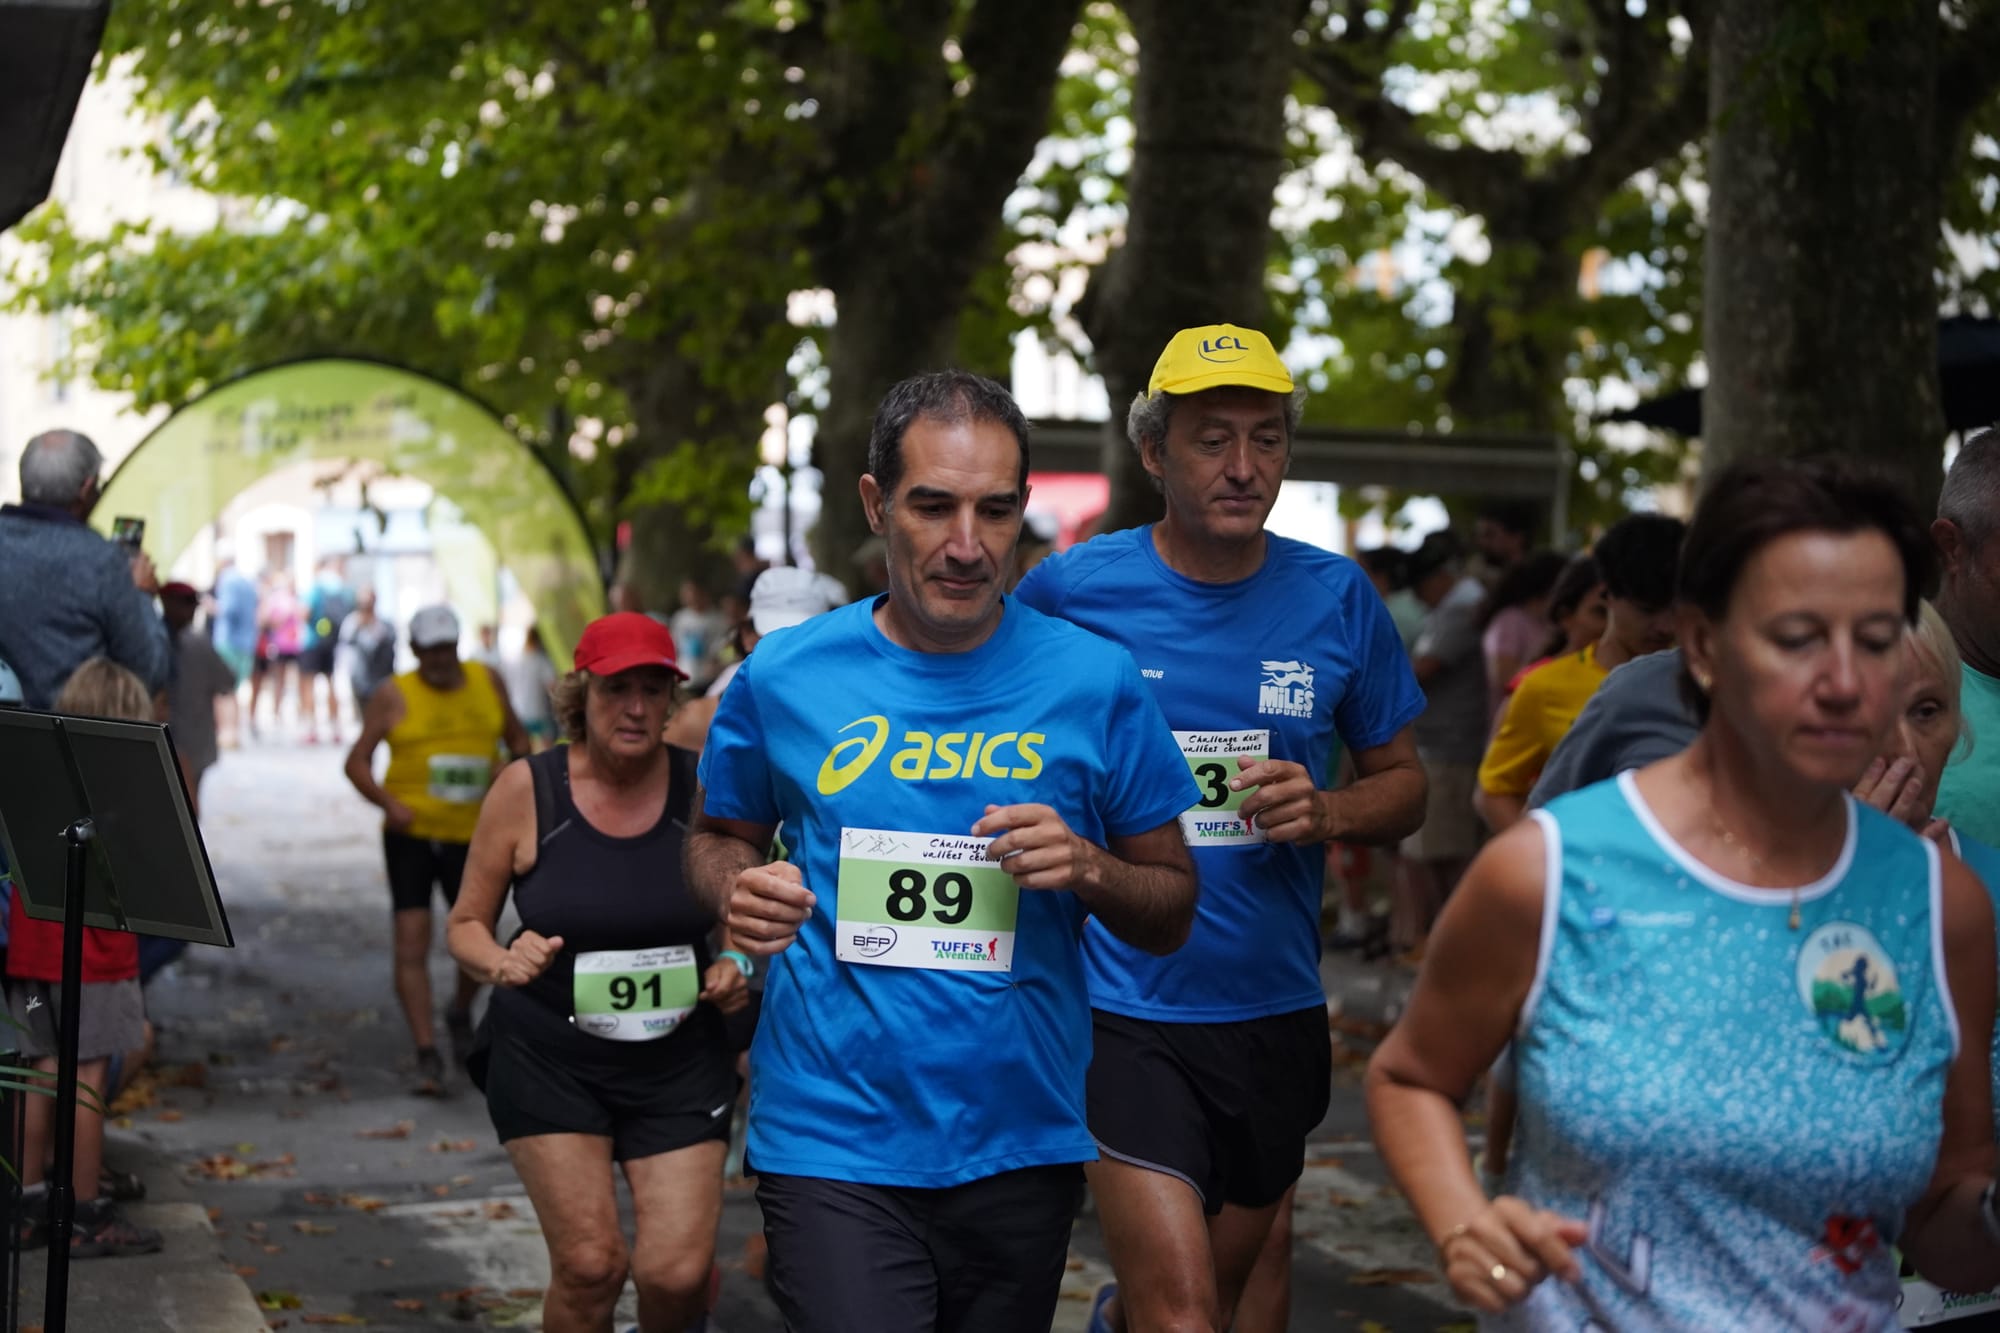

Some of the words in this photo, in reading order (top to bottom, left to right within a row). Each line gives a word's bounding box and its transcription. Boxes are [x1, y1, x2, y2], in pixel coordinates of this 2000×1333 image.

[1203, 336, 1248, 352] LCL
[1258, 706, 1312, 719] REPUBLIC
[1189, 734, 1237, 746] Challenge
[1242, 733, 1257, 742] des
[1194, 763, 1229, 808] 3
[1195, 821, 1241, 831] TUFF'S
[1199, 829, 1246, 838] Aventure
[929, 838, 986, 853] Challenge
[922, 850, 963, 860] vallées
[886, 869, 973, 924] 89
[853, 935, 890, 948] BFP
[931, 940, 983, 953] TUFF'S
[936, 949, 987, 961] Aventure
[609, 973, 661, 1011] 91
